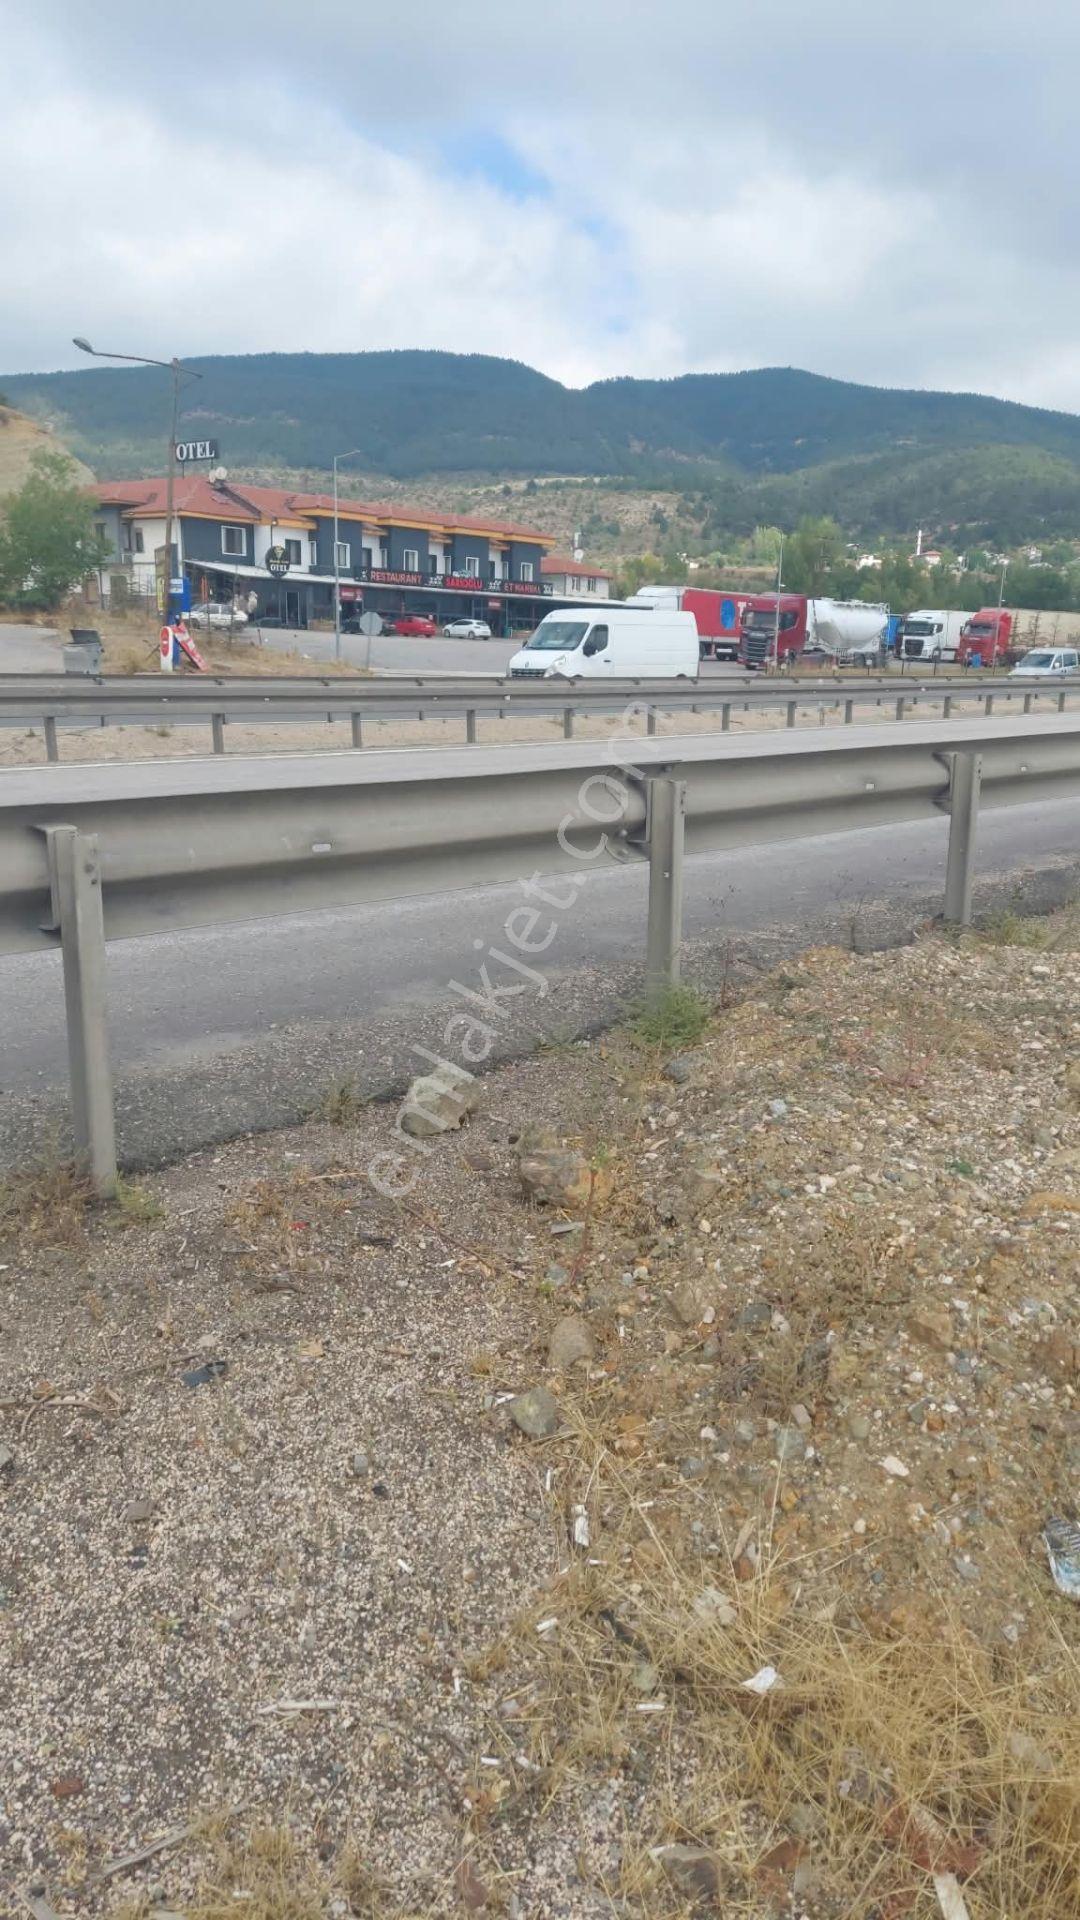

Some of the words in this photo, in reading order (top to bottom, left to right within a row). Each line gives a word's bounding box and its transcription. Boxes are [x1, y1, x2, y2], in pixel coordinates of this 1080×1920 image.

[176, 440, 215, 461] OTEL
[270, 564, 288, 572] OTEL
[370, 570, 423, 585] RESTAURANT
